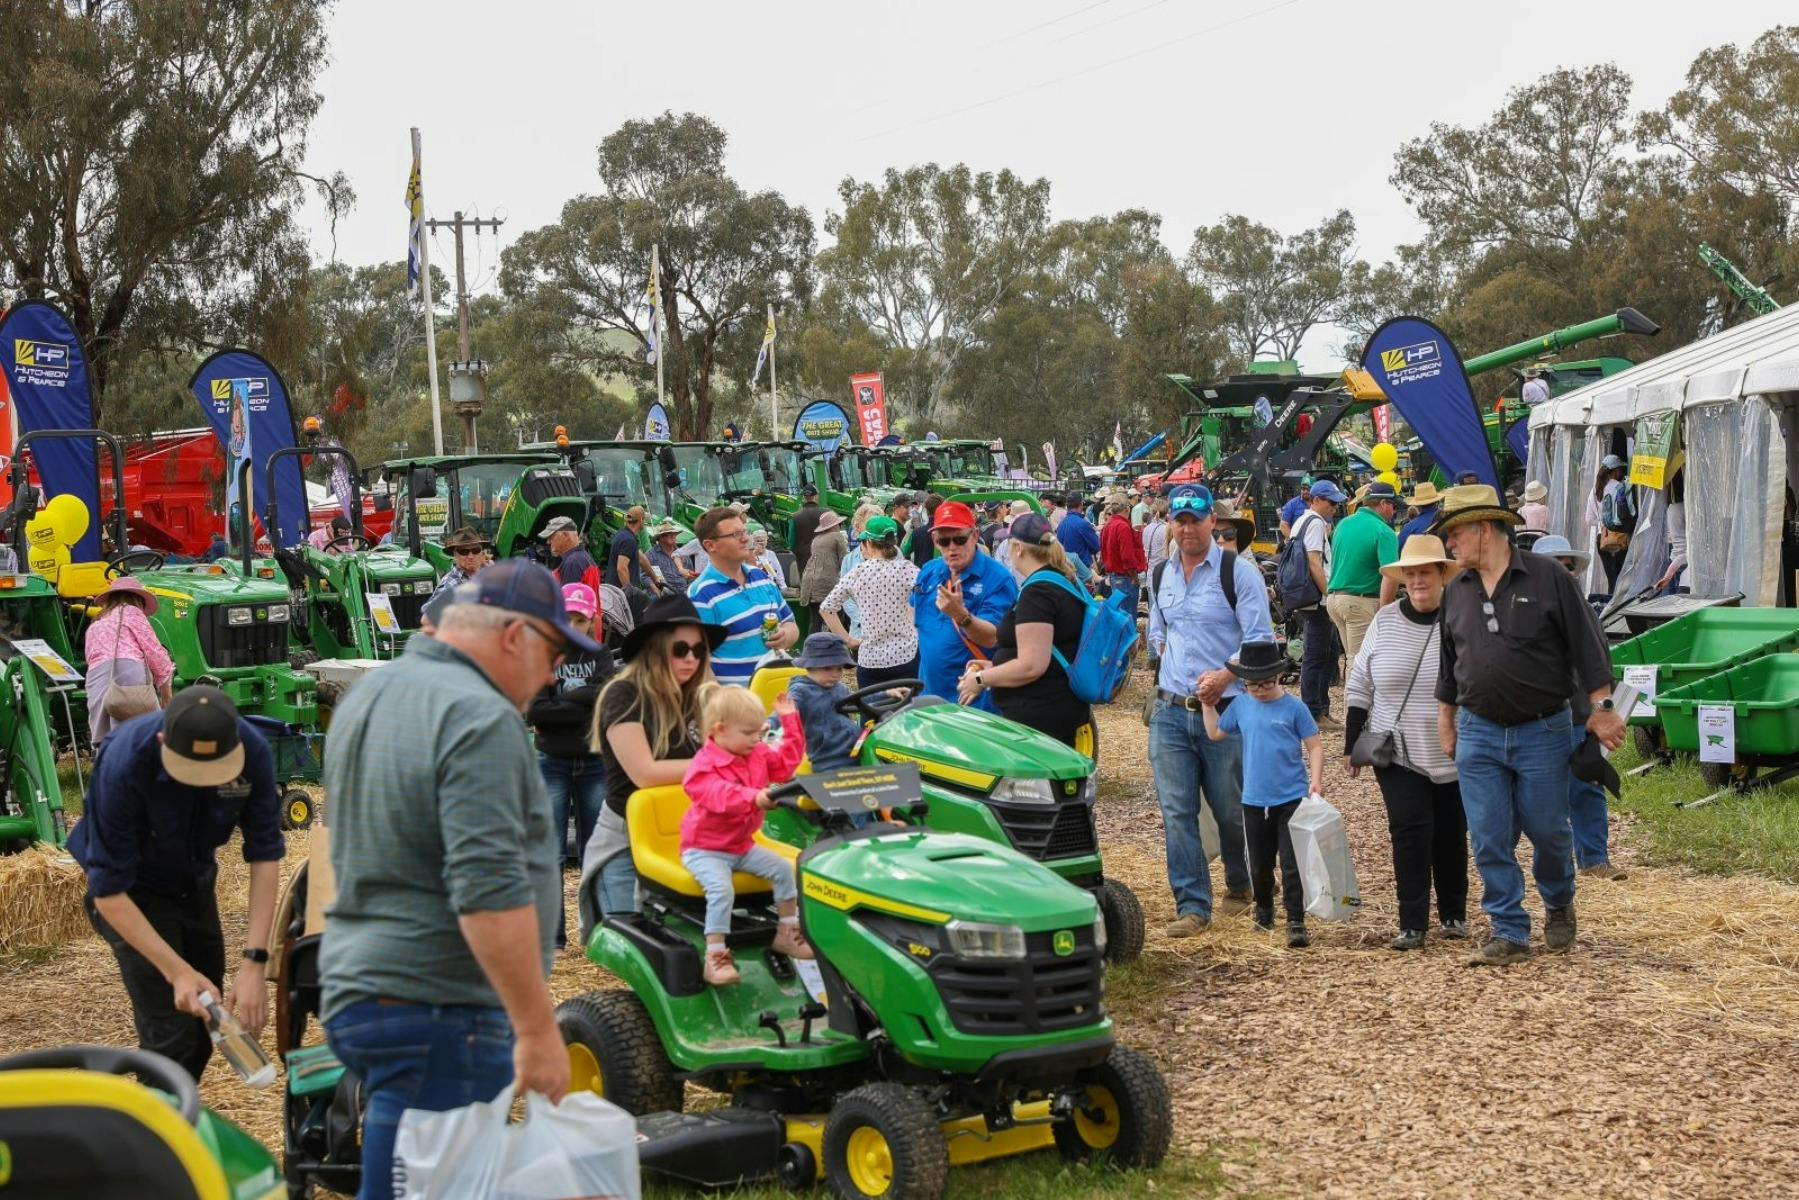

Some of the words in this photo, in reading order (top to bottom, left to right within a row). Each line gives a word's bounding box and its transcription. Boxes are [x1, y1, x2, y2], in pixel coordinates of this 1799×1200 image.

[36, 347, 65, 362] HP
[1407, 346, 1434, 362] HP
[14, 365, 69, 379] HUTCHEON
[1387, 361, 1442, 380] HUTCHEON
[1400, 369, 1440, 384] PEARCE
[27, 376, 66, 388] PEARCE
[1274, 400, 1297, 428] DEERE
[803, 421, 818, 432] THE
[819, 420, 842, 431] GREAT
[806, 881, 823, 893] JOHN
[823, 886, 848, 902] DEERE
